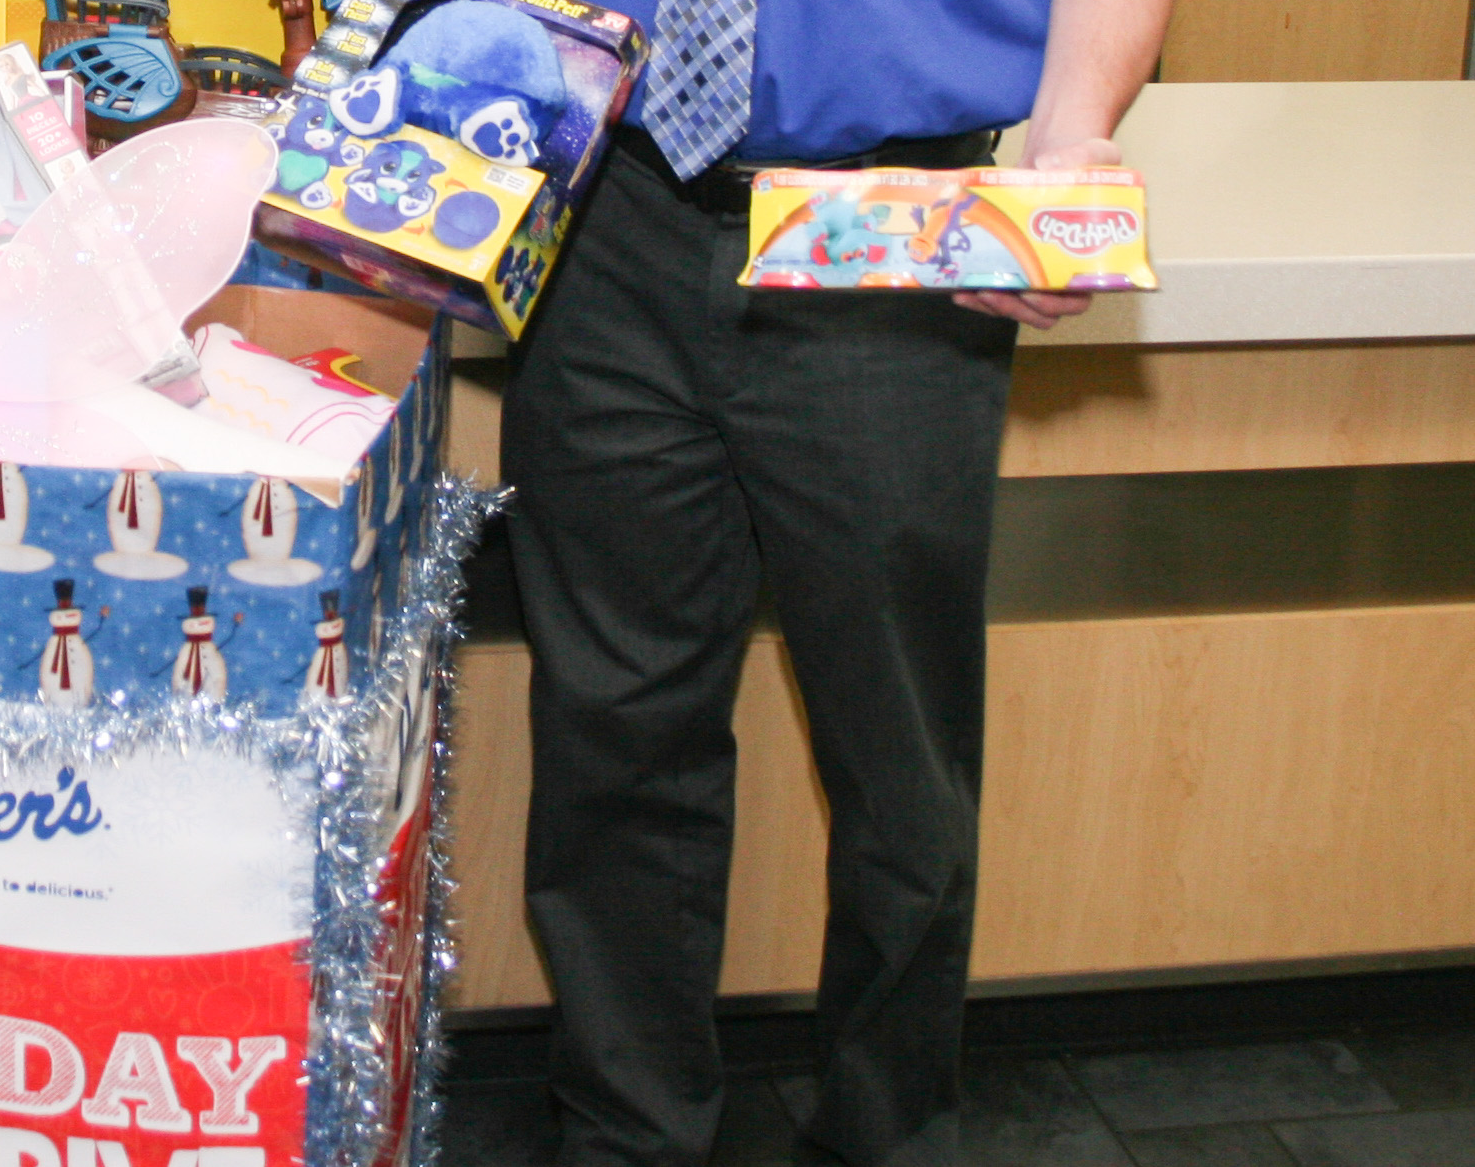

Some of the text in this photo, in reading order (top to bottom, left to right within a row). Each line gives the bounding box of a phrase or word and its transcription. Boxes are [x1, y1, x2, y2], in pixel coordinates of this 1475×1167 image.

[28, 111, 45, 123] 10
[37, 131, 62, 148] 20+
[1038, 213, 1137, 248] Play-Doh
[2, 878, 20, 891] to
[26, 880, 109, 900] delicious.
